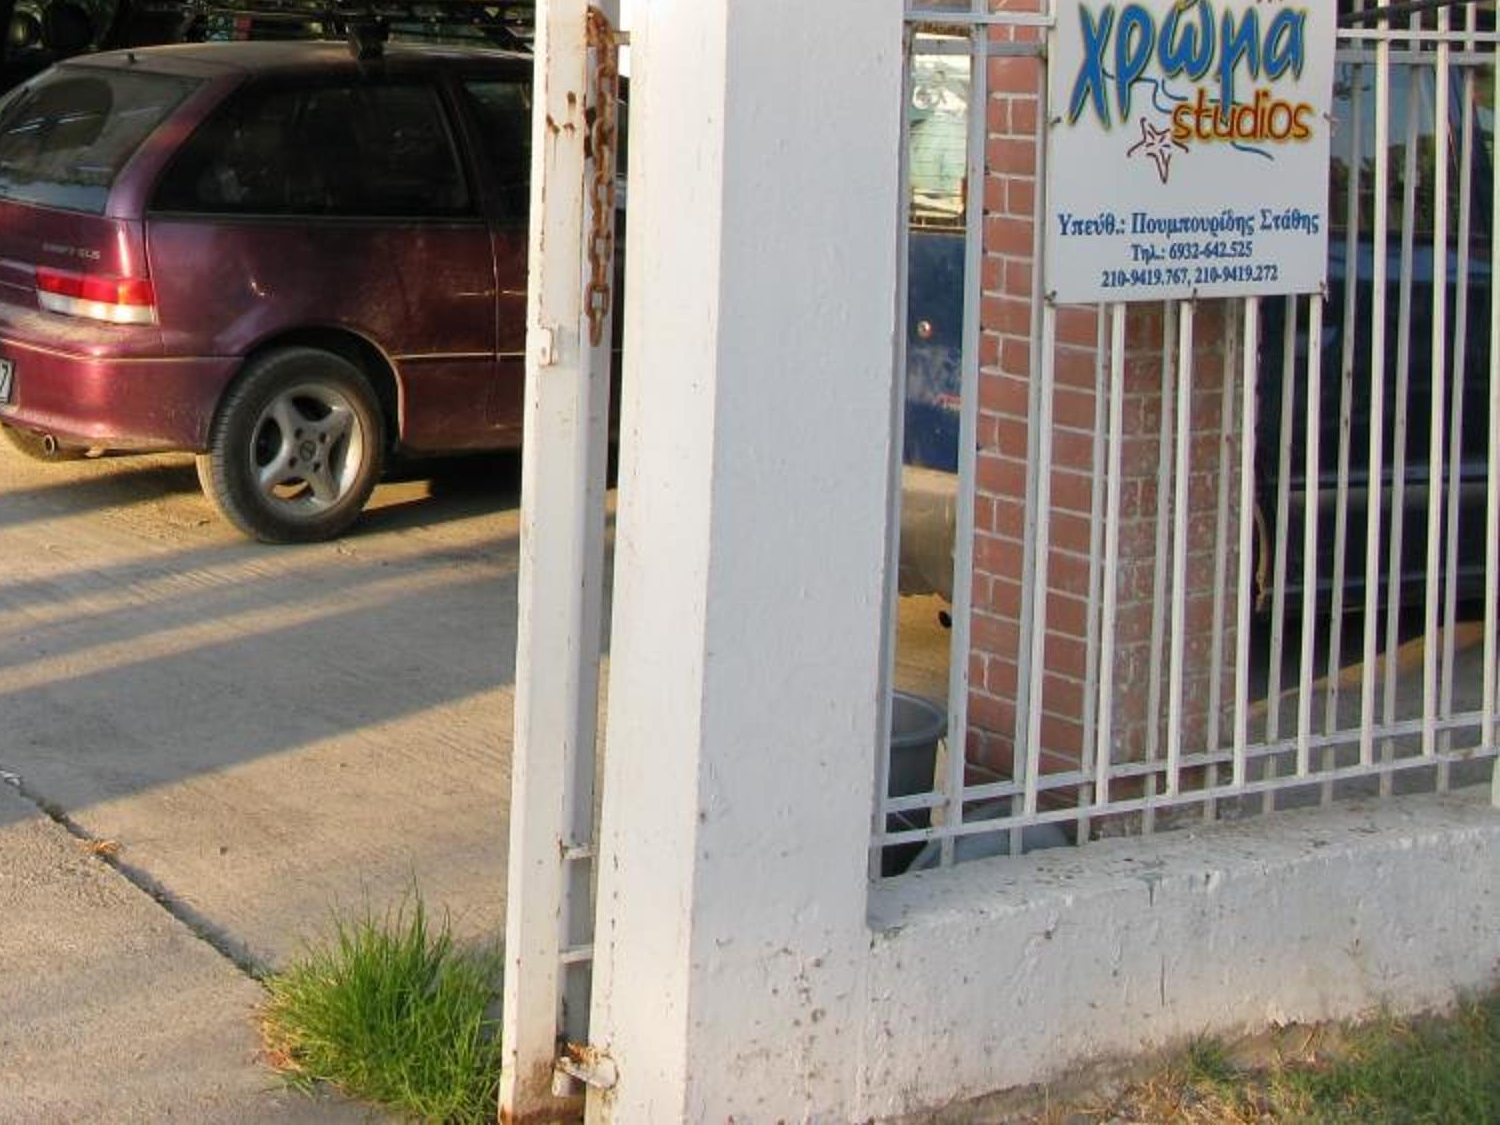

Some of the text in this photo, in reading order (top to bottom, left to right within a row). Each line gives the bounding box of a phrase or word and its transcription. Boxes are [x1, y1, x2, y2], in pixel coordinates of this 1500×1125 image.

[1173, 87, 1312, 142] studios
[1058, 208, 1319, 238] Υπεύθ.: Πουμπουρίδης Στάθης
[1169, 241, 1252, 260] 6932-642.525
[1194, 265, 1278, 284] 210-9419.272
